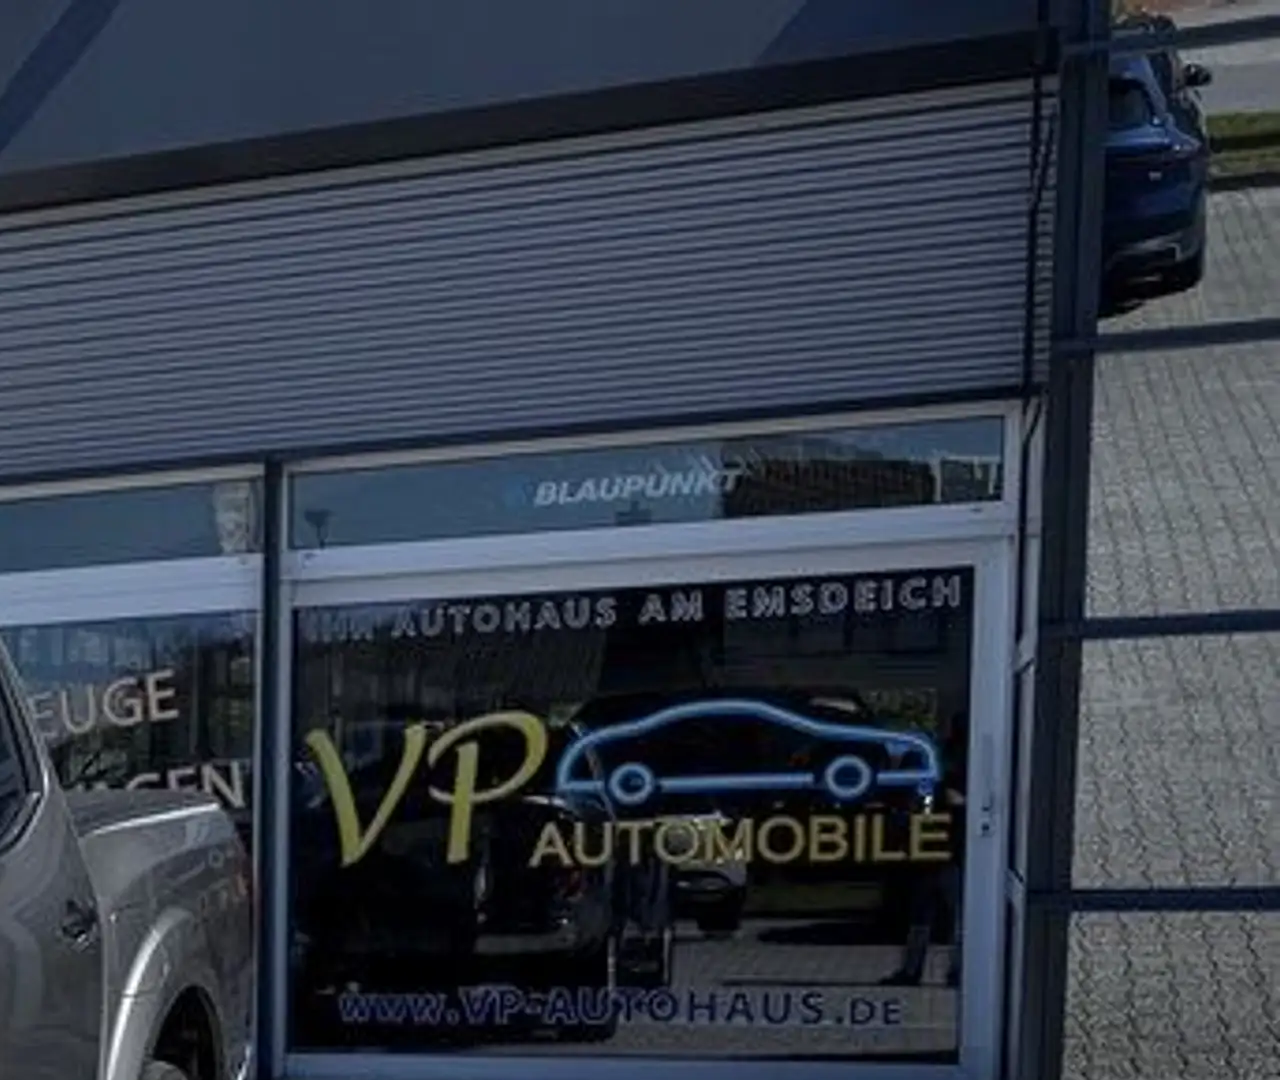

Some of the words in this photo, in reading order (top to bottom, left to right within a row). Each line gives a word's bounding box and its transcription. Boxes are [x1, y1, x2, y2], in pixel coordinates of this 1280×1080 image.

[534, 470, 743, 507] BLAUPUNKT
[390, 597, 617, 638] AUTOHAUS
[638, 589, 704, 626] AM
[724, 575, 962, 620] EMSDEICH
[306, 710, 548, 868] VP
[530, 813, 953, 868] AUTOMOBILE
